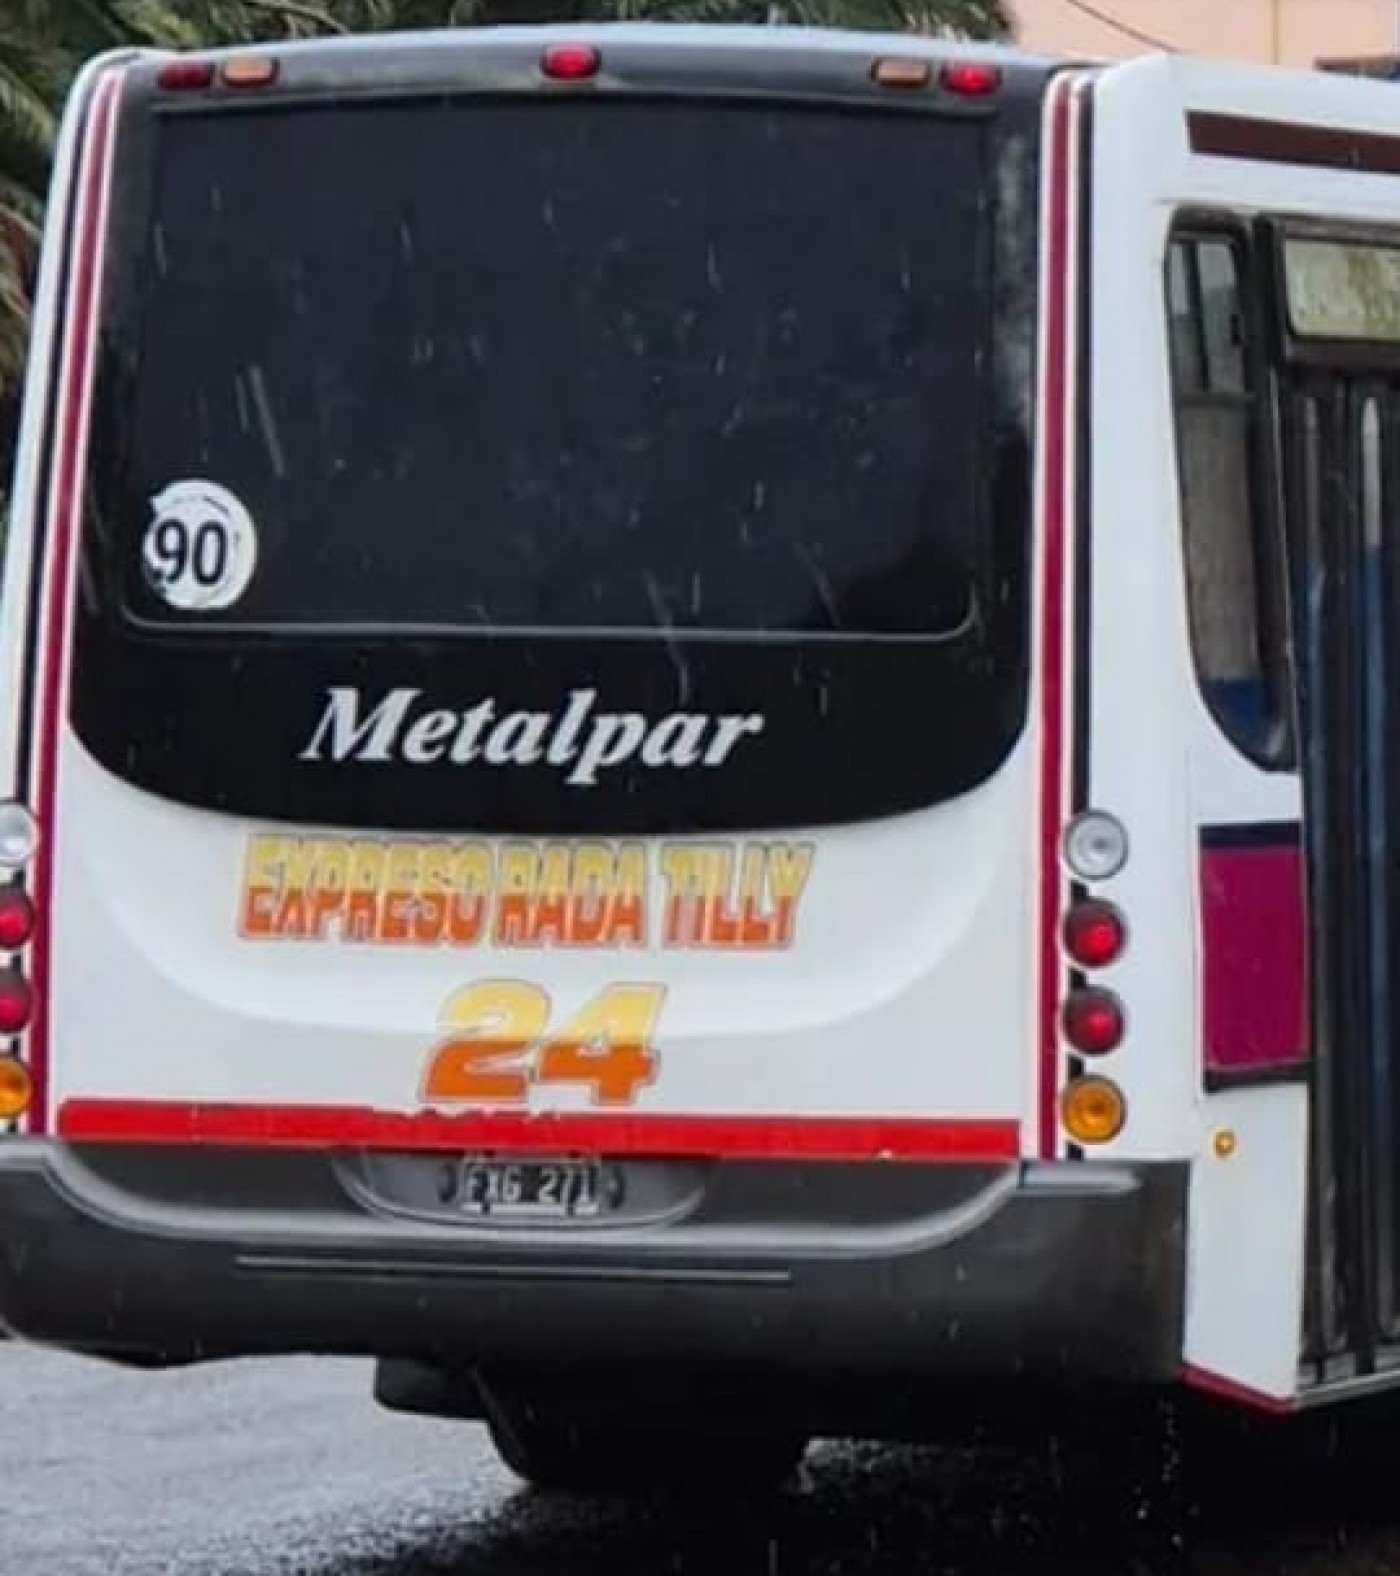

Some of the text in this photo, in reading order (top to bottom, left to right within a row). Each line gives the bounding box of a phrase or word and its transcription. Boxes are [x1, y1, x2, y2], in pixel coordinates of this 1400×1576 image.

[154, 516, 228, 587] 90
[299, 687, 766, 786] Metalpar
[239, 833, 816, 951] EXPRESO RADA TILLY
[417, 979, 668, 1108] 24
